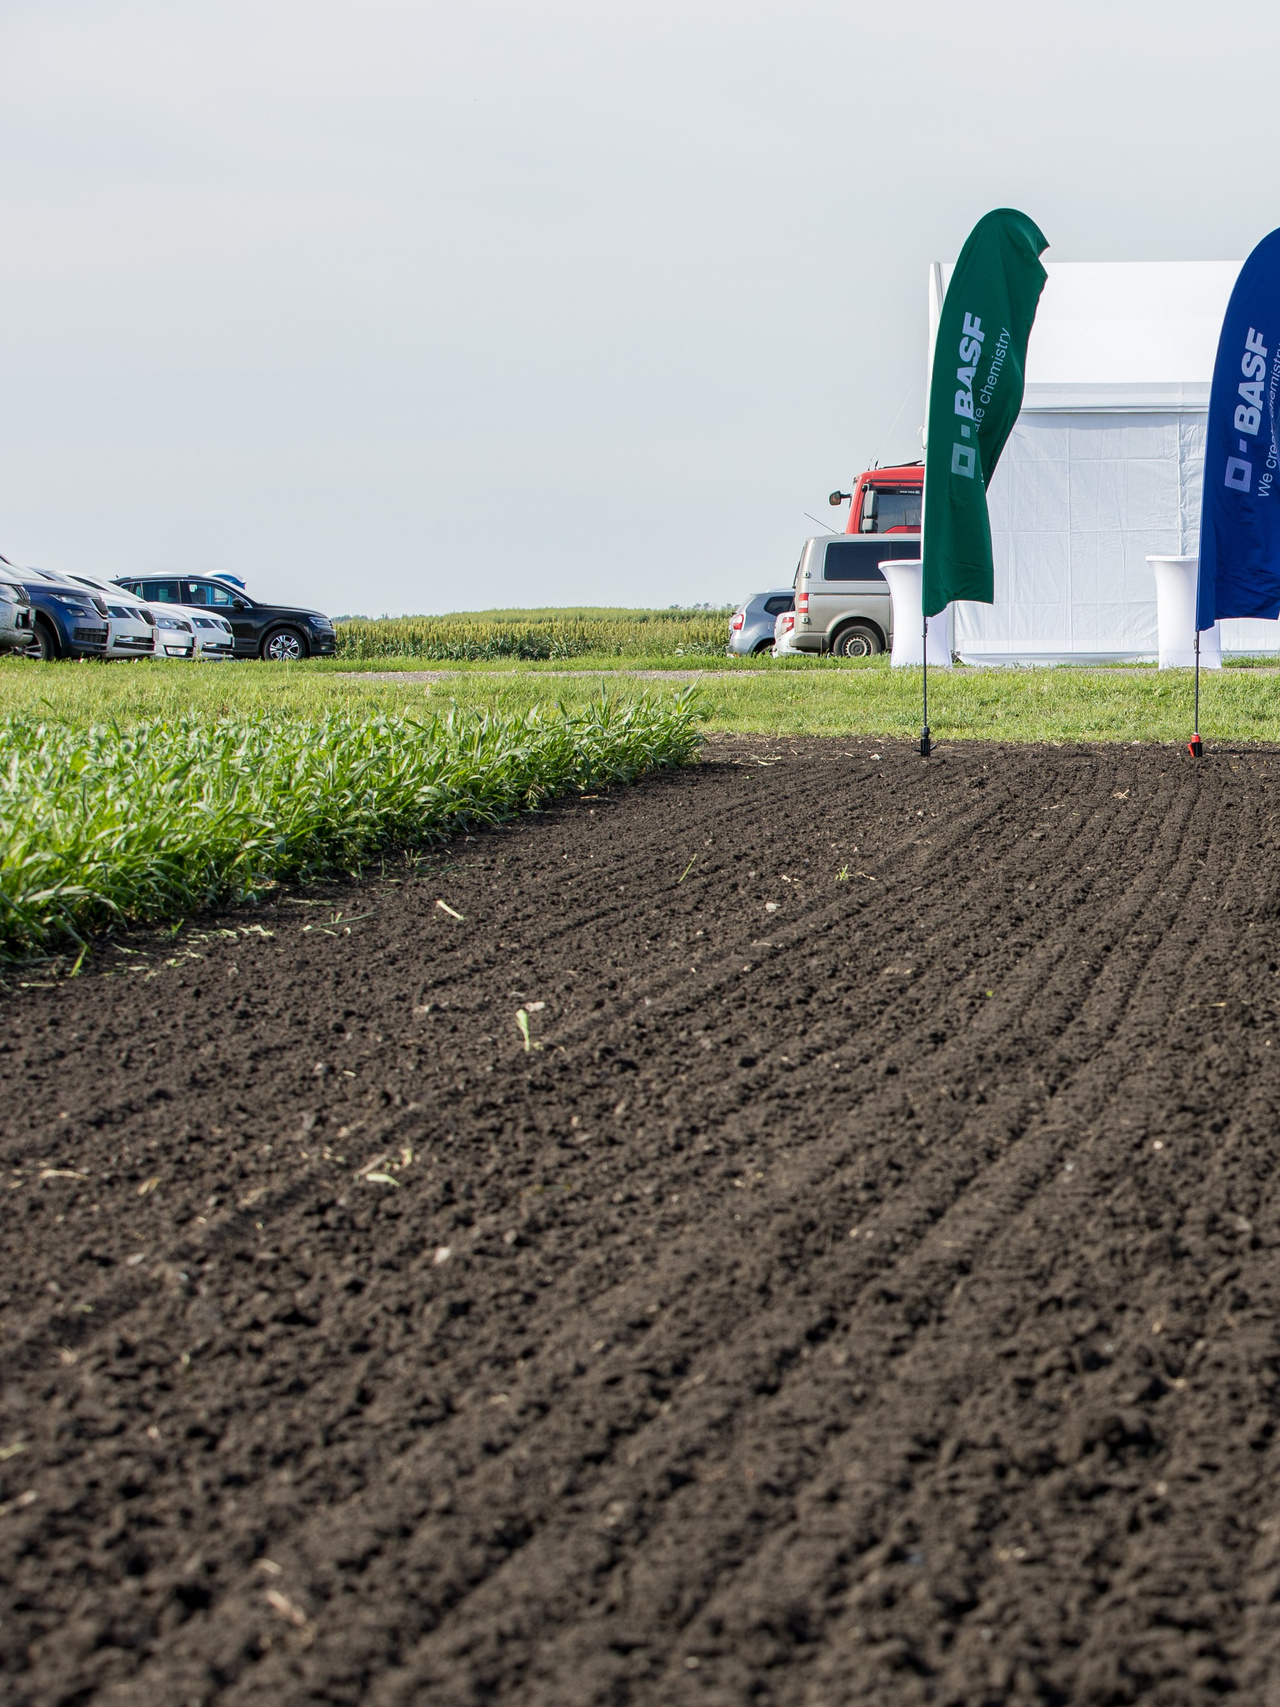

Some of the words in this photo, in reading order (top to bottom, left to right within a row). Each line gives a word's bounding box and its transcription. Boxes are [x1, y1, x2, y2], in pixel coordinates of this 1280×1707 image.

[954, 311, 985, 420] BASF
[980, 327, 1010, 404] chemistry
[1234, 326, 1268, 436] BASF
[1258, 473, 1273, 497] We
